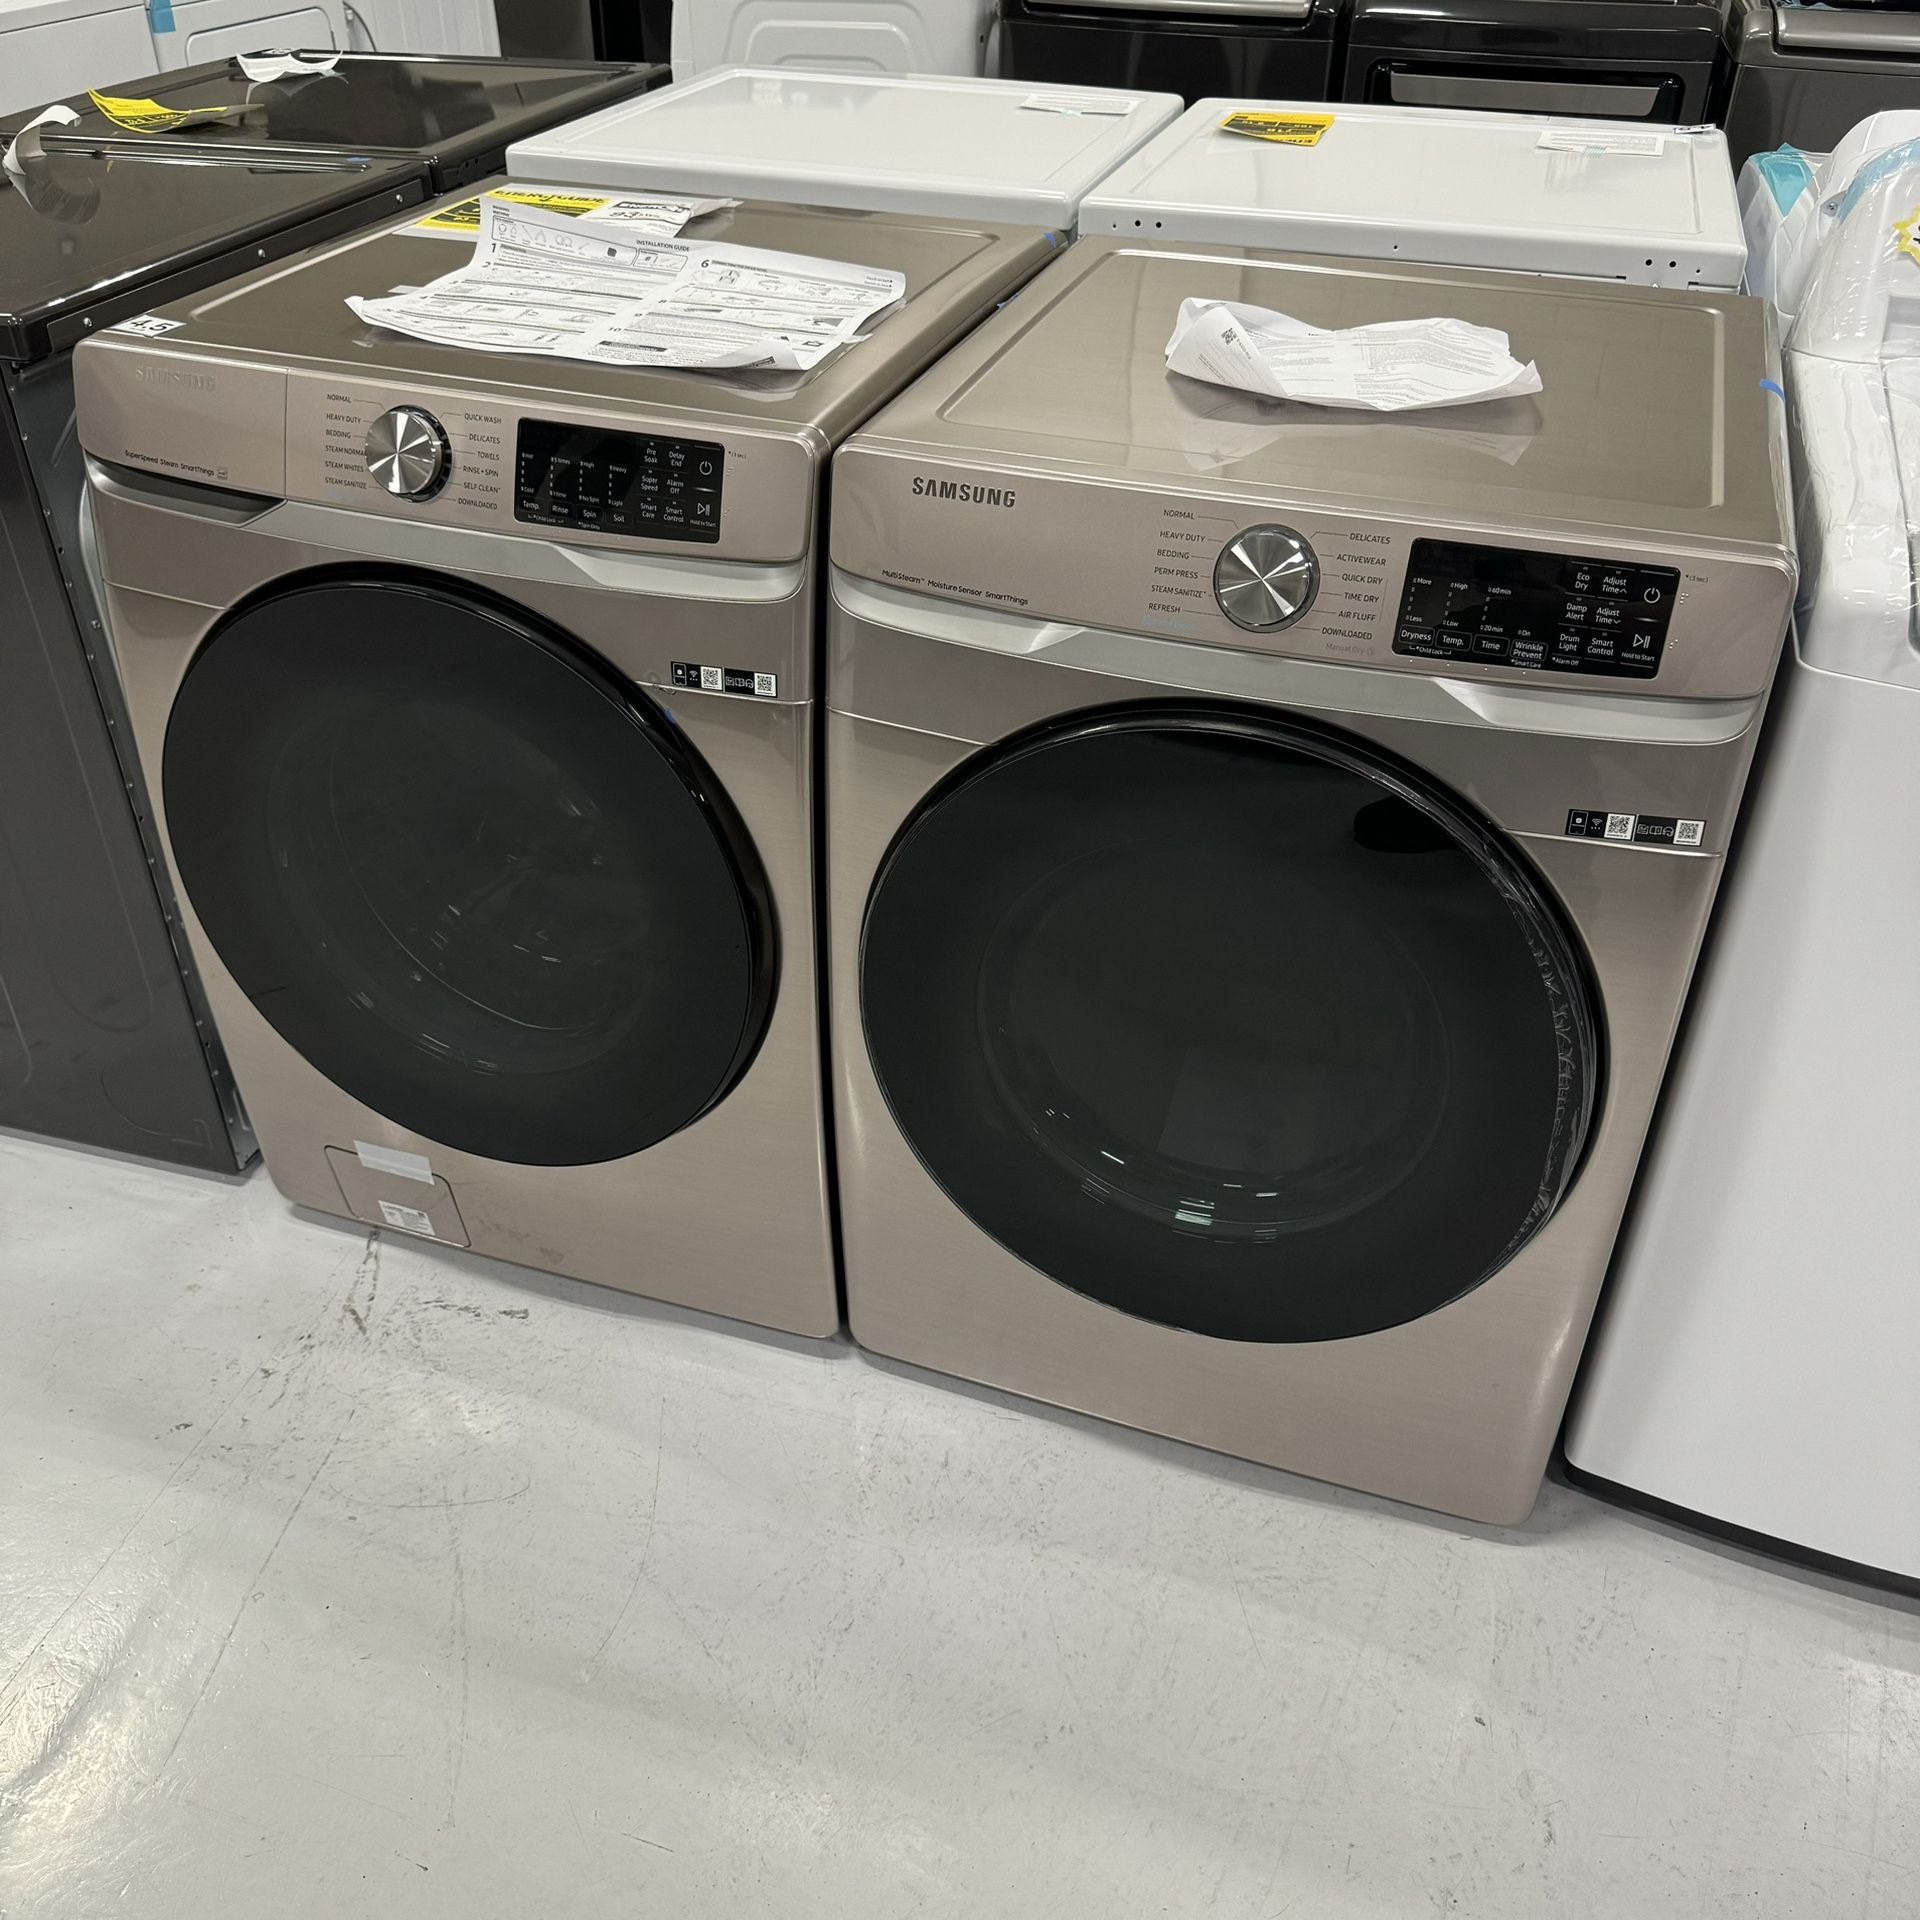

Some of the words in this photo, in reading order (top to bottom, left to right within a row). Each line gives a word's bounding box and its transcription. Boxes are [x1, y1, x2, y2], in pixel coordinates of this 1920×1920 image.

[491, 243, 497, 253] 1
[636, 239, 673, 250] INSTALLATION
[674, 244, 690, 252] GUIDE
[700, 259, 710, 268] 6
[135, 367, 217, 393] SAMSUNG
[327, 393, 352, 403] NORMAL
[326, 413, 347, 423] HEAVY
[347, 416, 362, 424] DUTY
[464, 412, 483, 422] QUICK
[484, 415, 502, 424] WASH
[325, 429, 352, 439] BEDDING
[469, 433, 501, 444] DELICATES
[325, 444, 344, 453] STEAM
[344, 447, 365, 456] NORMA
[647, 448, 657, 456] Pre
[477, 451, 500, 461] TOWELS
[644, 455, 658, 464] Soak
[669, 451, 685, 461] Delay
[125, 449, 158, 463] SuperSpeed
[160, 458, 179, 468] Steam
[180, 463, 215, 476] SmartThings
[325, 461, 343, 469] STEAM
[344, 463, 364, 473] WHITES
[462, 465, 480, 475] RINSE
[485, 468, 499, 477] SPIN
[325, 476, 343, 485] STEAM
[343, 479, 367, 490] SANITIZE
[641, 475, 658, 485] Super
[667, 480, 684, 488] Alarm
[463, 481, 478, 490] SELF
[640, 482, 658, 492] Speed
[669, 486, 680, 494] Off
[912, 476, 1017, 508] SAMSUNG
[458, 498, 498, 510] DOWNLOADED
[640, 503, 657, 512] Smart
[552, 505, 569, 515] Rinse
[583, 509, 597, 519] Spin
[641, 511, 655, 519] Care
[665, 506, 683, 516] Smart
[1163, 509, 1196, 520] NORMAL
[613, 514, 625, 523] Soil
[663, 514, 684, 523] Control
[1159, 530, 1186, 541] HEAVY
[1186, 533, 1206, 543] DUTY
[1349, 532, 1391, 545] DELICATES
[1156, 549, 1190, 560] BEDDING
[1336, 553, 1387, 567] ACTIVEWEAR
[1154, 566, 1174, 577] PERM
[1174, 568, 1199, 579] PRESS
[1576, 572, 1590, 582] Eco
[1341, 573, 1365, 585] QUICK
[1366, 575, 1383, 585] DRY
[1417, 577, 1432, 585] More
[1603, 576, 1627, 587] Adjust
[1151, 584, 1174, 594] STEAM
[1454, 582, 1468, 590] High
[1575, 581, 1589, 591] Dry
[1602, 585, 1620, 594] Time
[927, 579, 958, 592] Moisture
[958, 585, 983, 597] Sensor
[985, 590, 1029, 606] SmartThings
[1344, 592, 1362, 602] TIME
[1363, 593, 1380, 604] DRY
[1148, 602, 1181, 614] REFRESH
[1566, 603, 1588, 613] Damp
[1596, 607, 1620, 617] Adjust
[1338, 610, 1351, 620] AIR
[1352, 611, 1376, 622] FLUFF
[1565, 612, 1584, 621] Alert
[1595, 616, 1613, 625] Time
[1321, 626, 1373, 641] DOWNLOADED
[1401, 629, 1432, 641] Dryness
[1559, 633, 1580, 643] Drum
[1442, 634, 1464, 646] Temp.
[1591, 637, 1614, 648] Smart
[1481, 640, 1501, 651] Time
[1515, 641, 1544, 652] Wrinkle
[1558, 642, 1578, 652] Light
[1513, 649, 1542, 660] Prevent
[1587, 646, 1614, 657] Control
[1621, 651, 1635, 659] Hold
[1641, 654, 1655, 662] Start
[1556, 657, 1570, 665] Alarm
